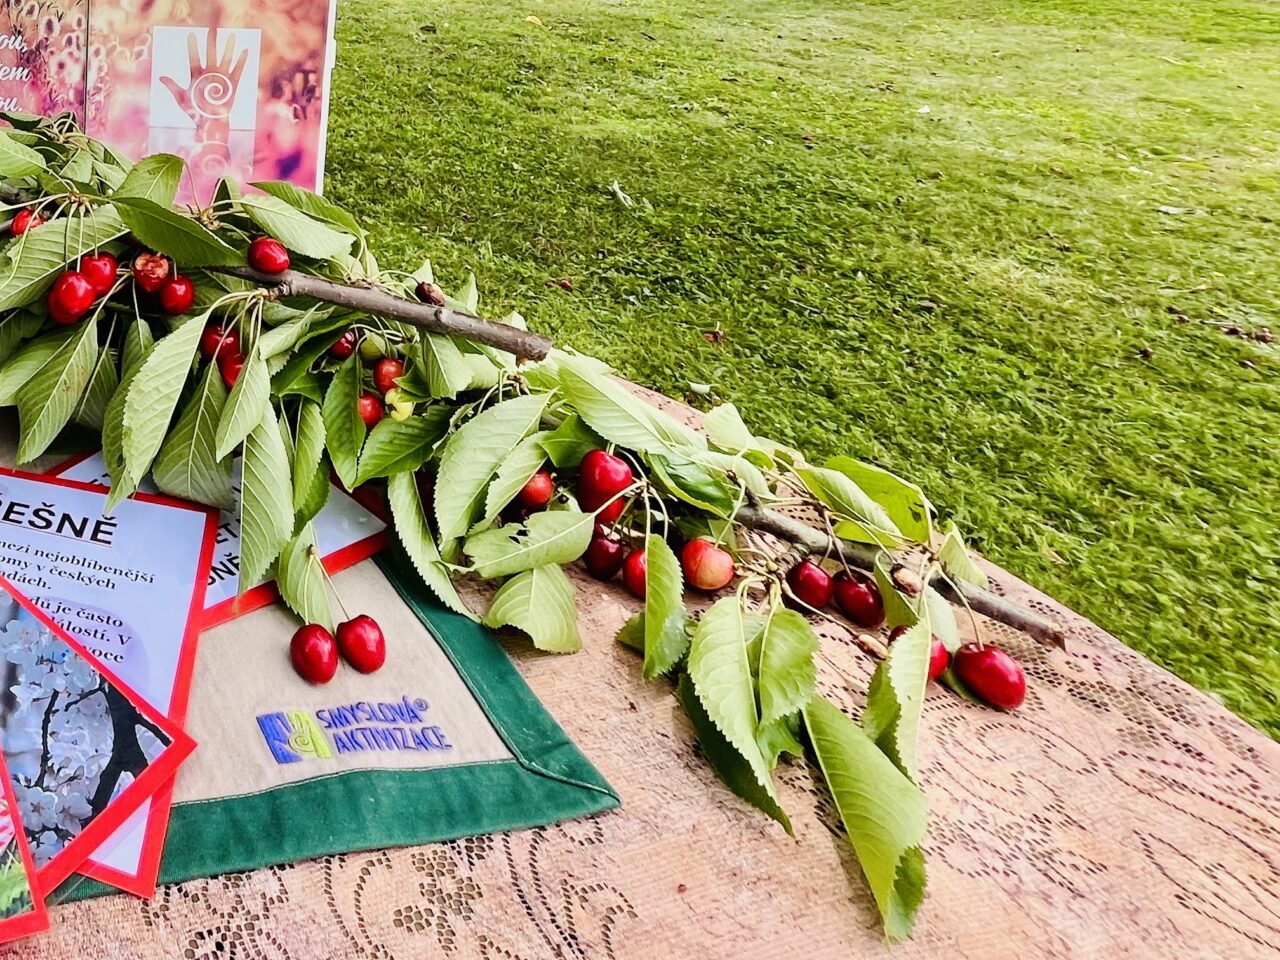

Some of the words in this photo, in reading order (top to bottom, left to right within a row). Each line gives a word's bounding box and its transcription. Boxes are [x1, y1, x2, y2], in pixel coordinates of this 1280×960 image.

[34, 546, 155, 585] nejoblíbenější
[36, 564, 46, 572] v
[49, 565, 117, 590] českých
[51, 602, 72, 614] je
[76, 607, 124, 628] často
[333, 725, 453, 754] AKTIVIZACE
